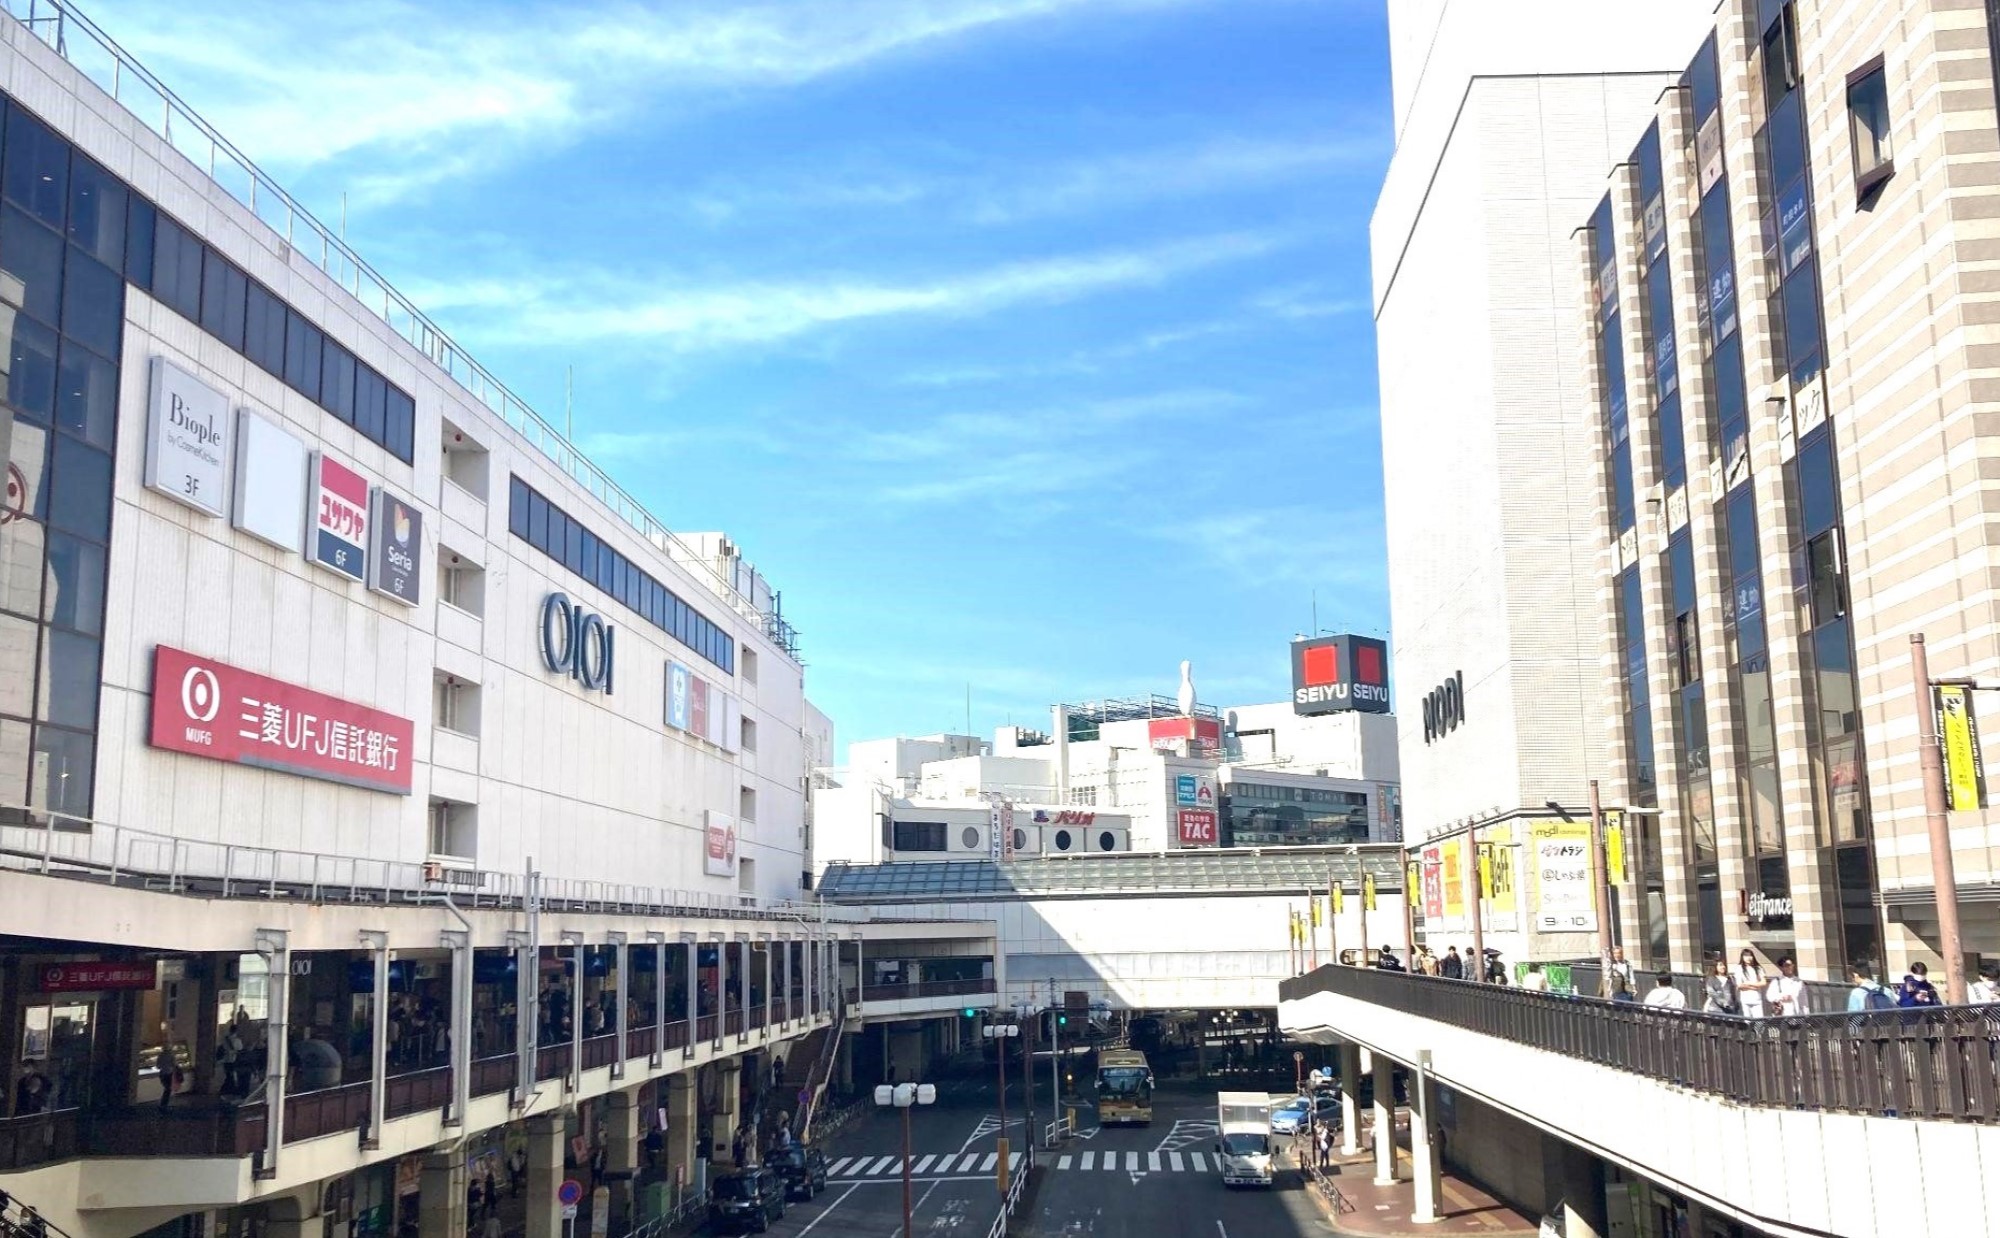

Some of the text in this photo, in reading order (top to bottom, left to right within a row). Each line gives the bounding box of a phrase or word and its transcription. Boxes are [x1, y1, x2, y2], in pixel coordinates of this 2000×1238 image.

[169, 392, 221, 447] Biople
[185, 474, 200, 496] 3F
[335, 548, 347, 567] 6F
[388, 545, 412, 571] Seria
[1296, 683, 1348, 704] SEIYU
[1353, 683, 1388, 702] SEIYU
[185, 726, 212, 746] MUFG
[239, 696, 399, 771] 三菱UFJ信託銀行
[1311, 791, 1345, 803] TOMAS
[1184, 823, 1210, 839] TAC
[1536, 825, 1559, 838] modi
